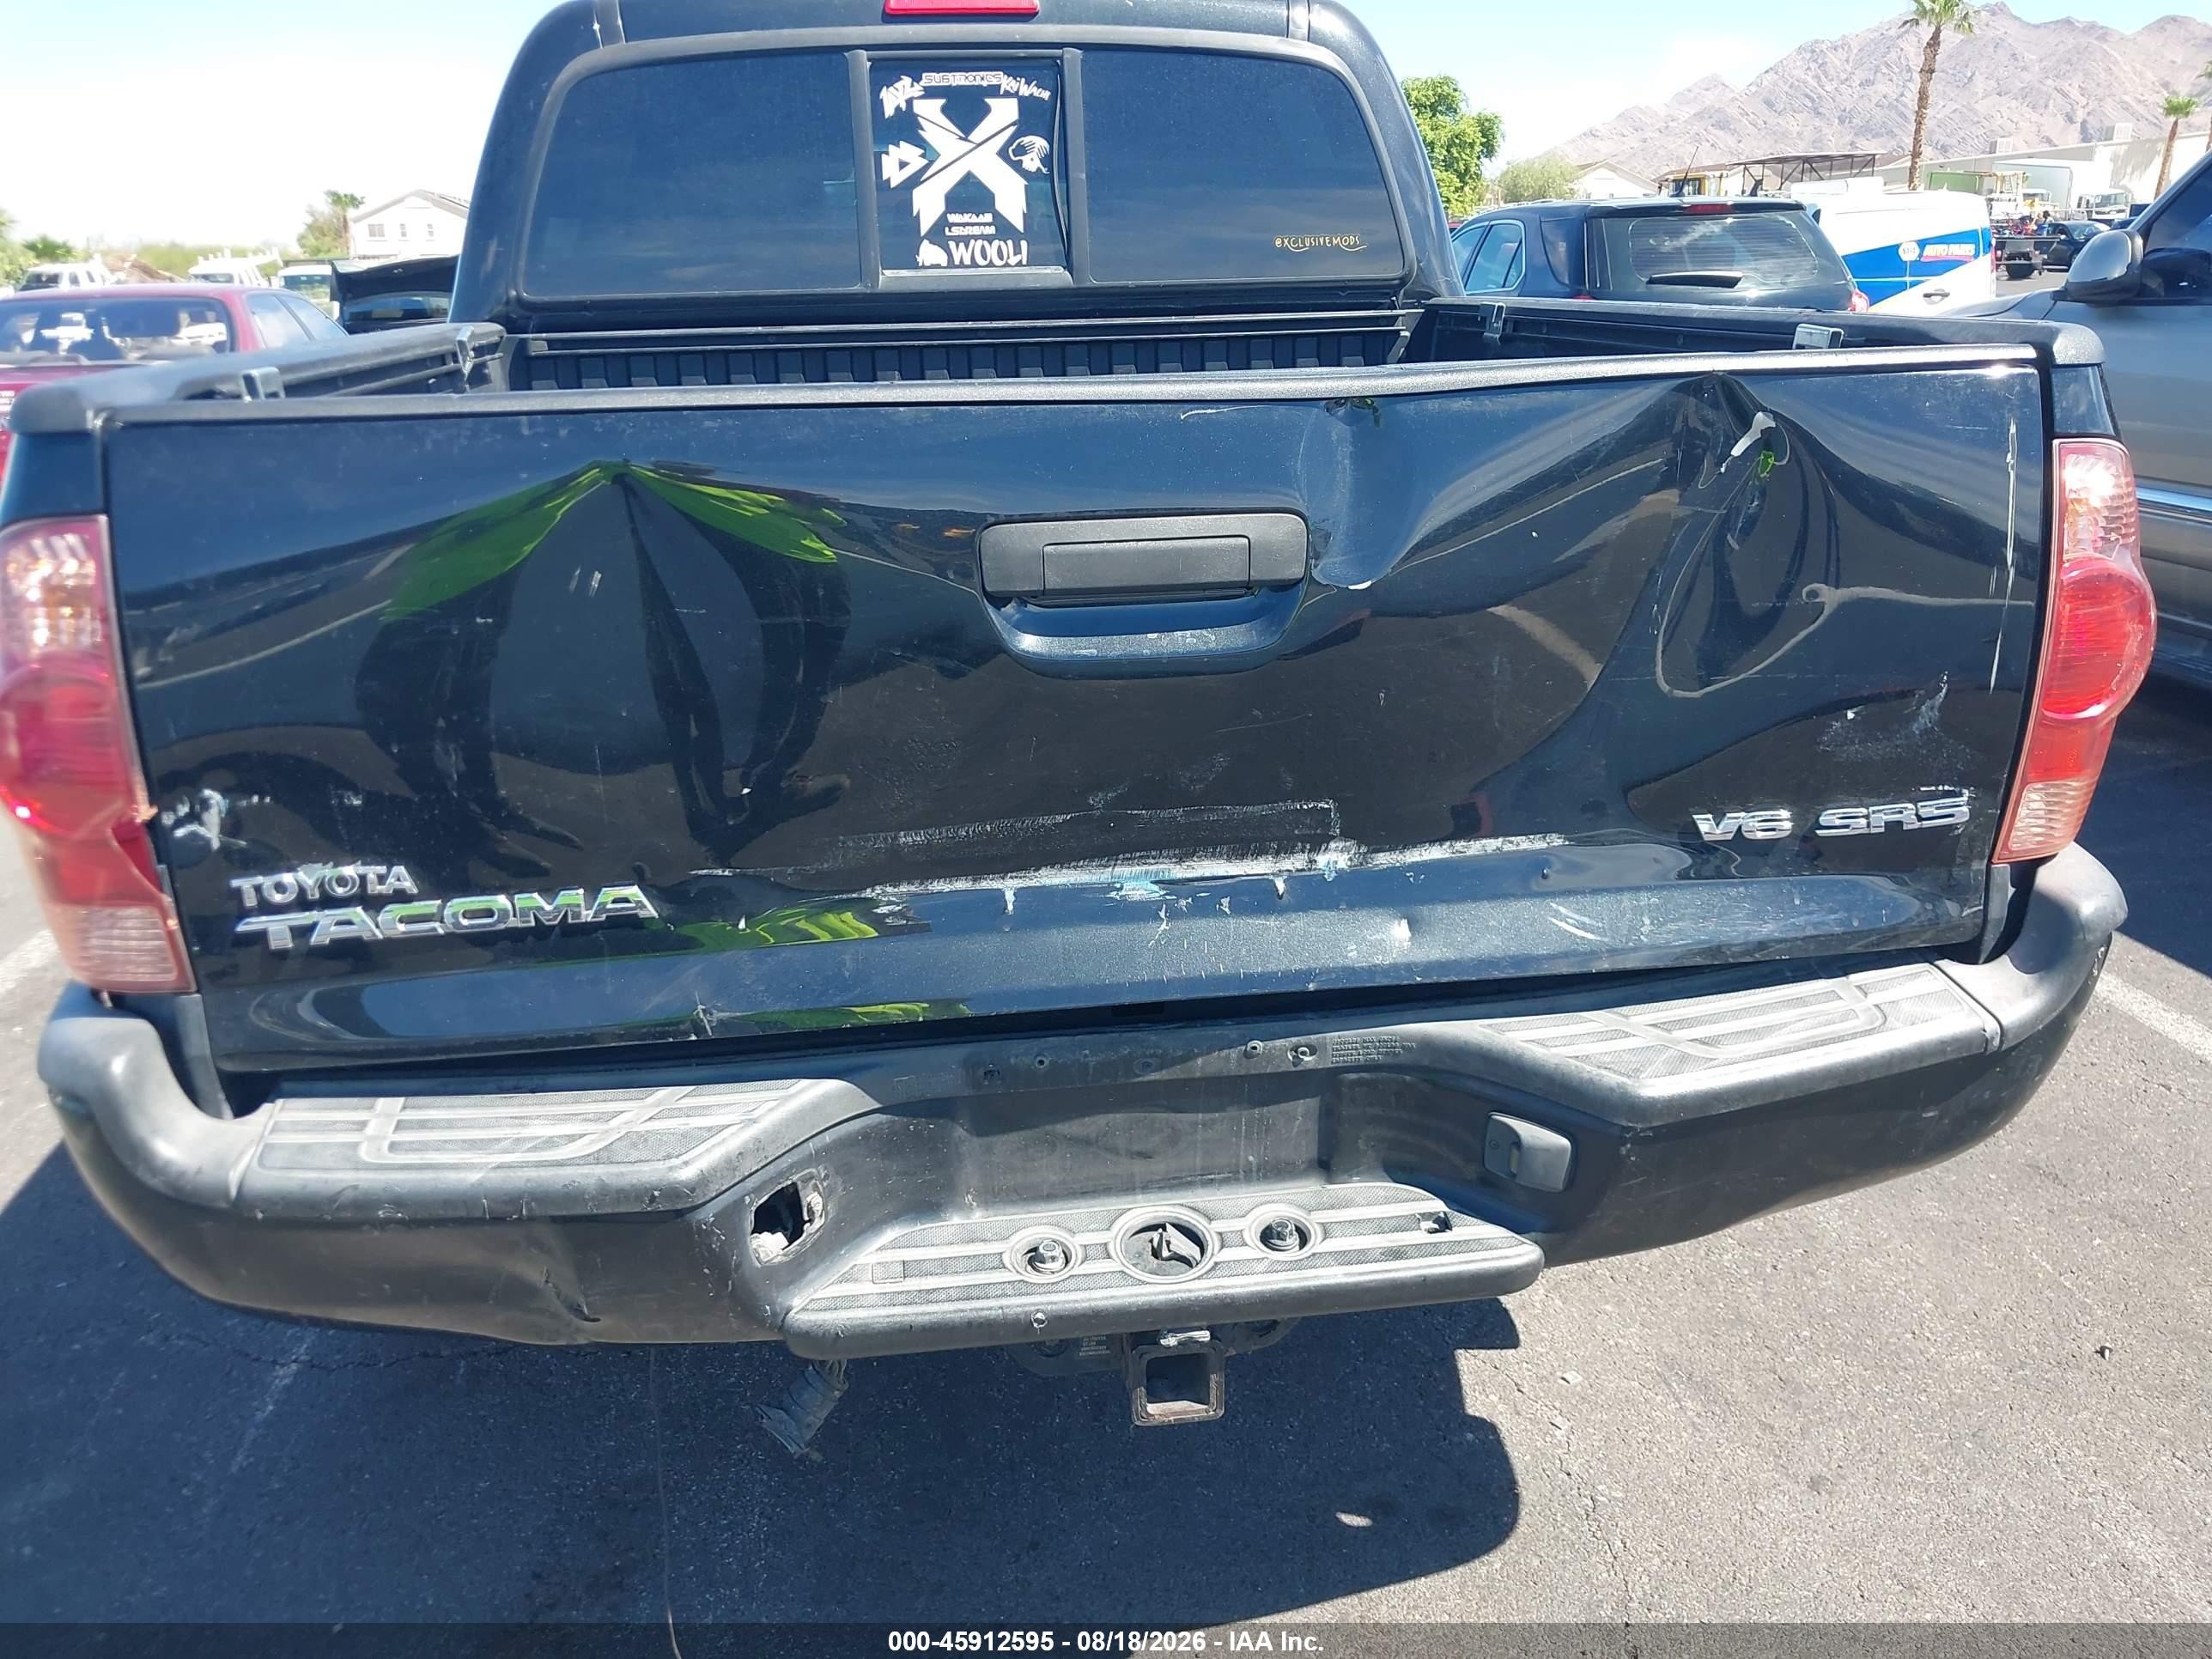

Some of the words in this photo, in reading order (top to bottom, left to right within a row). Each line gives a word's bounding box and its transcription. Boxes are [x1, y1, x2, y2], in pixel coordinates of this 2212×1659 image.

[947, 239, 1028, 266] WOOLI
[1692, 808, 1793, 842] V6
[1814, 795, 1972, 837] SR5
[229, 863, 420, 907] TOYOTA
[234, 883, 660, 951] TACOMA
